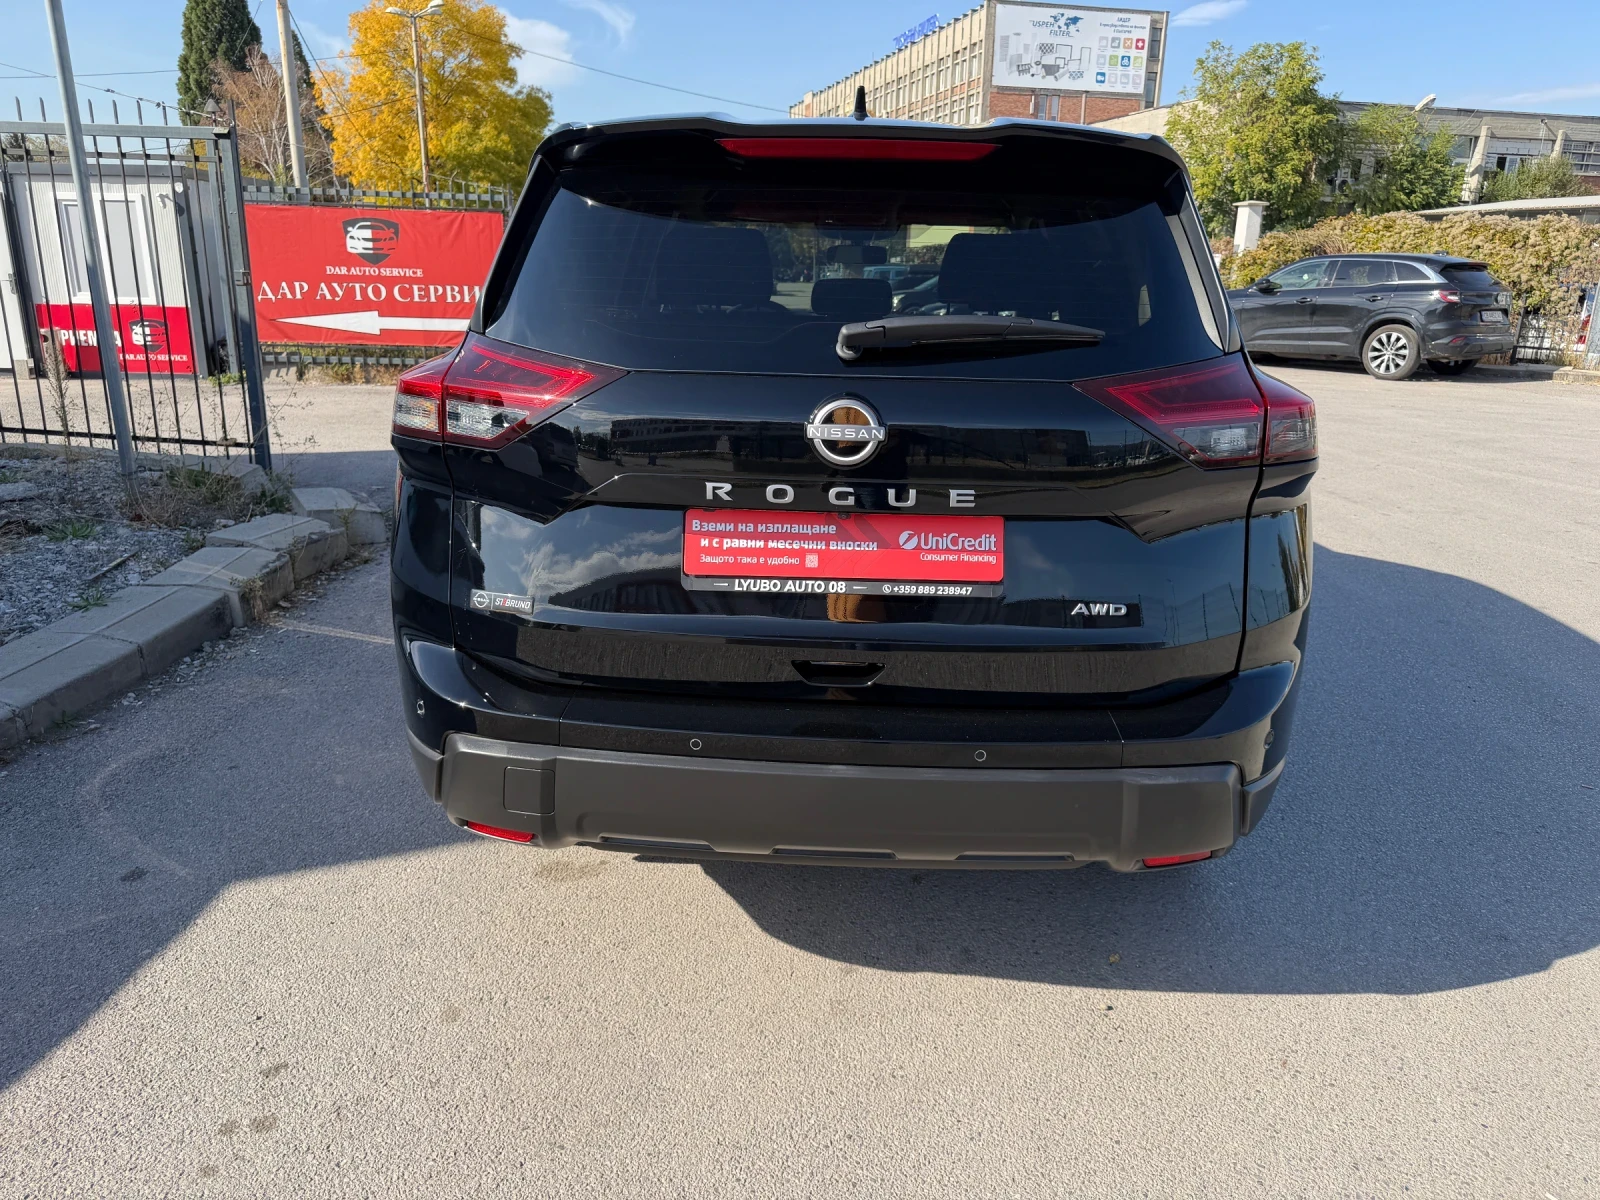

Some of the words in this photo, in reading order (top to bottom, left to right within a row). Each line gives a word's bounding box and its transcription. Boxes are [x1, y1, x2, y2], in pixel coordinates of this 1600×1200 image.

[325, 266, 348, 275] DAR
[350, 267, 379, 276] AUTO
[380, 268, 424, 277] SERVICE
[257, 281, 309, 303] ДАР
[316, 282, 387, 302] АУТО
[393, 283, 483, 304] СЕРВИ
[808, 427, 885, 440] NISSAN
[704, 481, 977, 508] ROGUE
[692, 519, 734, 533] Вземи
[738, 522, 754, 533] на
[757, 522, 837, 536] изплащане
[700, 538, 709, 547] и
[712, 538, 720, 548] с
[723, 538, 764, 550] равни
[768, 539, 826, 550] месечни
[829, 540, 878, 551] вноски
[921, 531, 997, 551] UniCredit
[700, 554, 734, 564] Защото
[737, 556, 758, 565] така
[759, 556, 765, 564] е
[767, 555, 800, 566] удобно
[920, 553, 959, 562] Consumer
[960, 553, 997, 564] Financing
[734, 579, 781, 592] LYUBO
[784, 580, 825, 593] AUTO
[828, 581, 846, 593] 08
[893, 585, 917, 594] +359
[918, 586, 937, 595] 889
[938, 586, 973, 596] 238947
[1070, 602, 1128, 616] AWD
